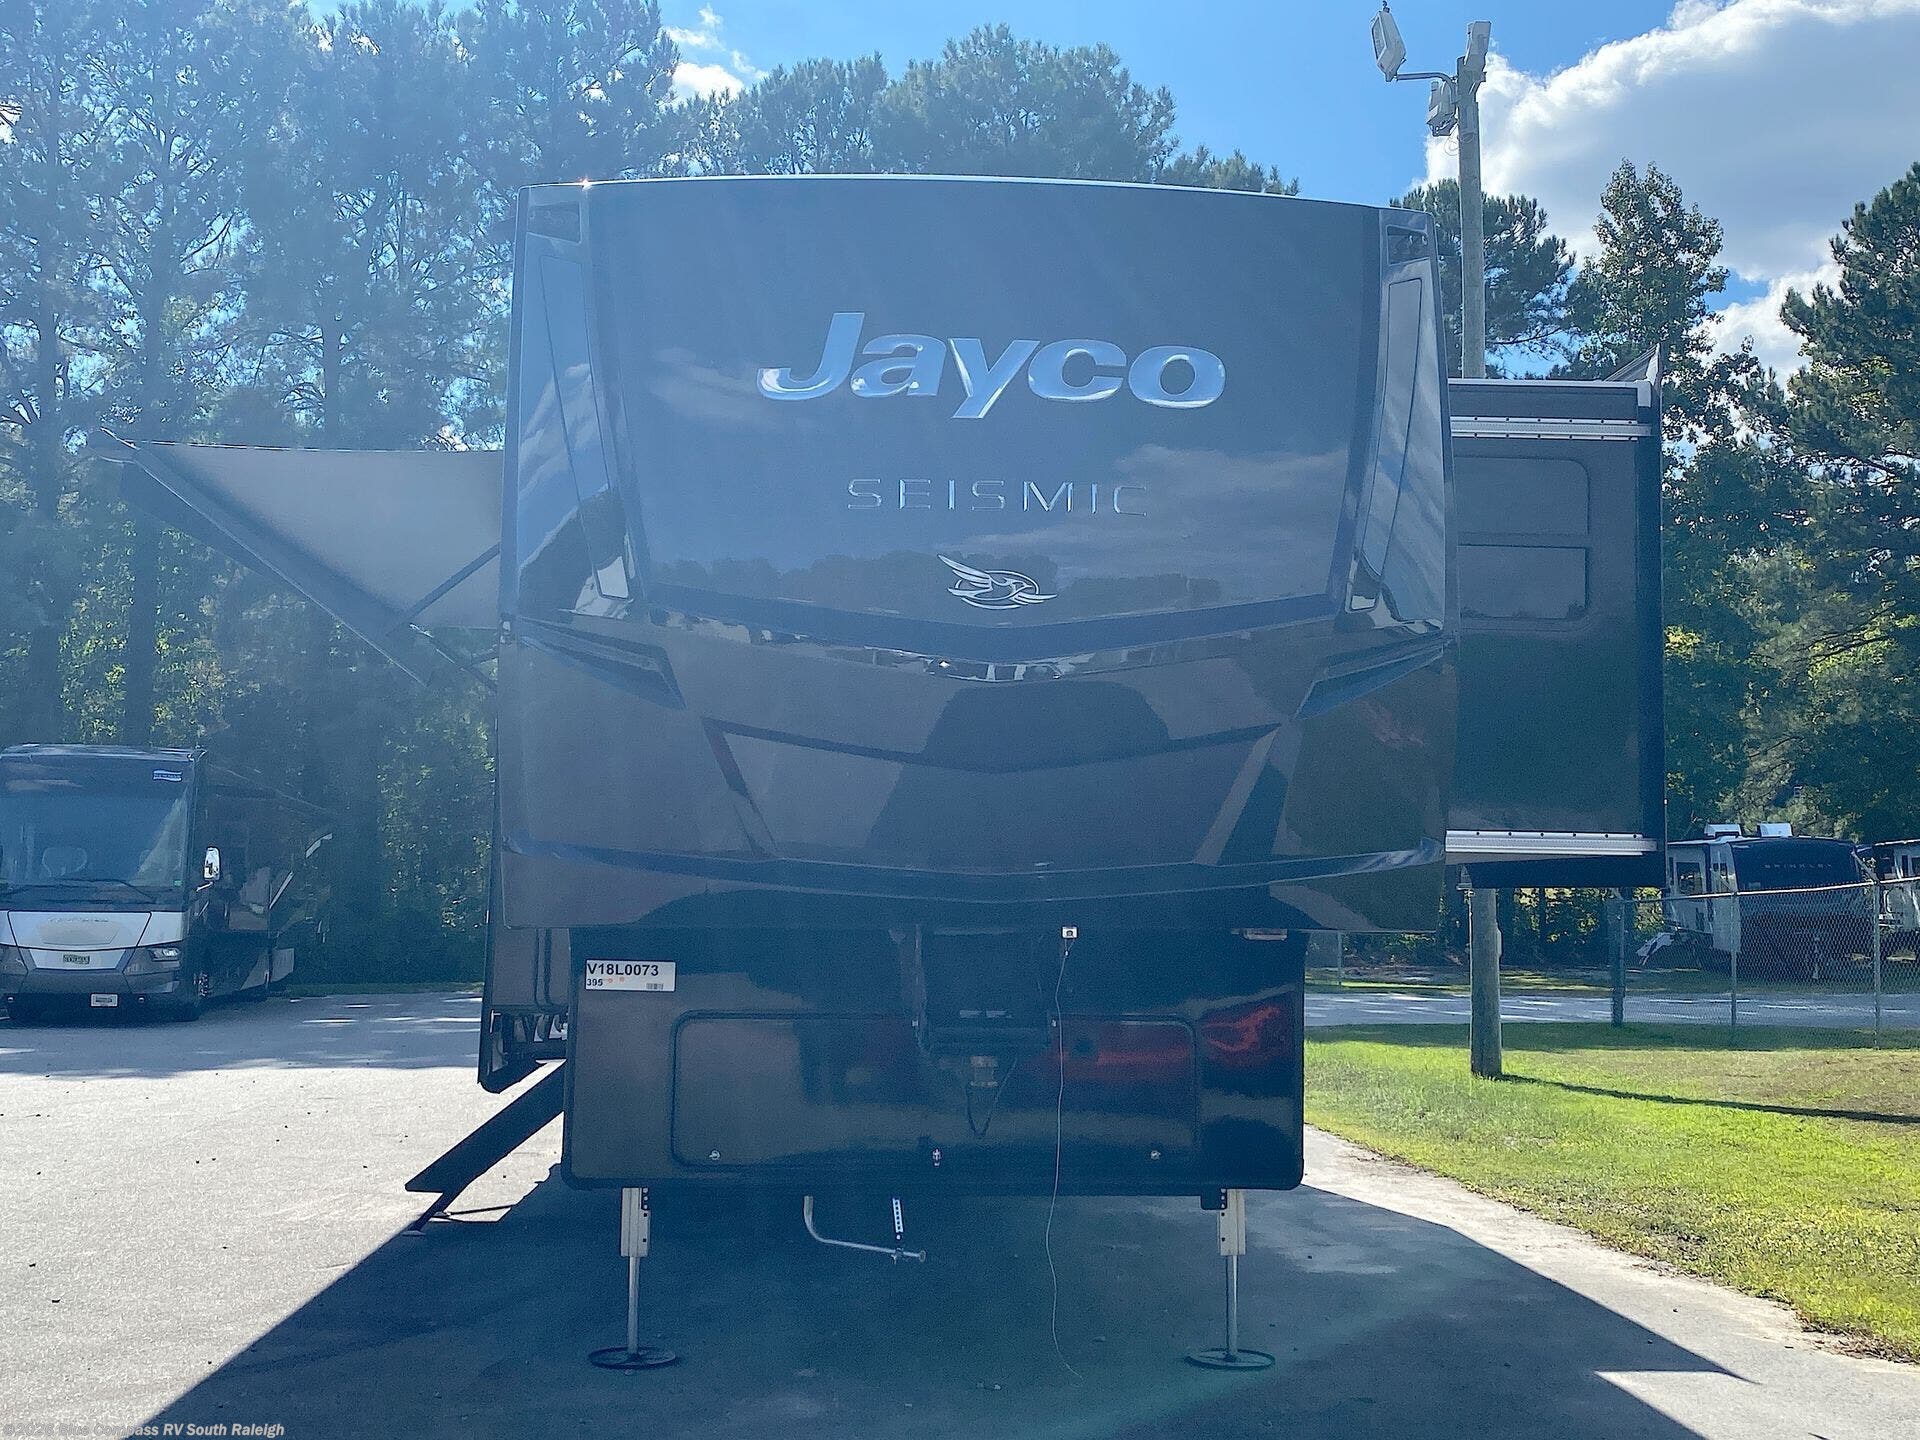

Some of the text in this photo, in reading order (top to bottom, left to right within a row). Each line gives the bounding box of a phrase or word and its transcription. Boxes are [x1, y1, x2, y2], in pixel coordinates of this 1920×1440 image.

[757, 311, 1226, 418] Jayco
[847, 478, 1147, 516] SEISMIC
[587, 963, 659, 976] V18L0073
